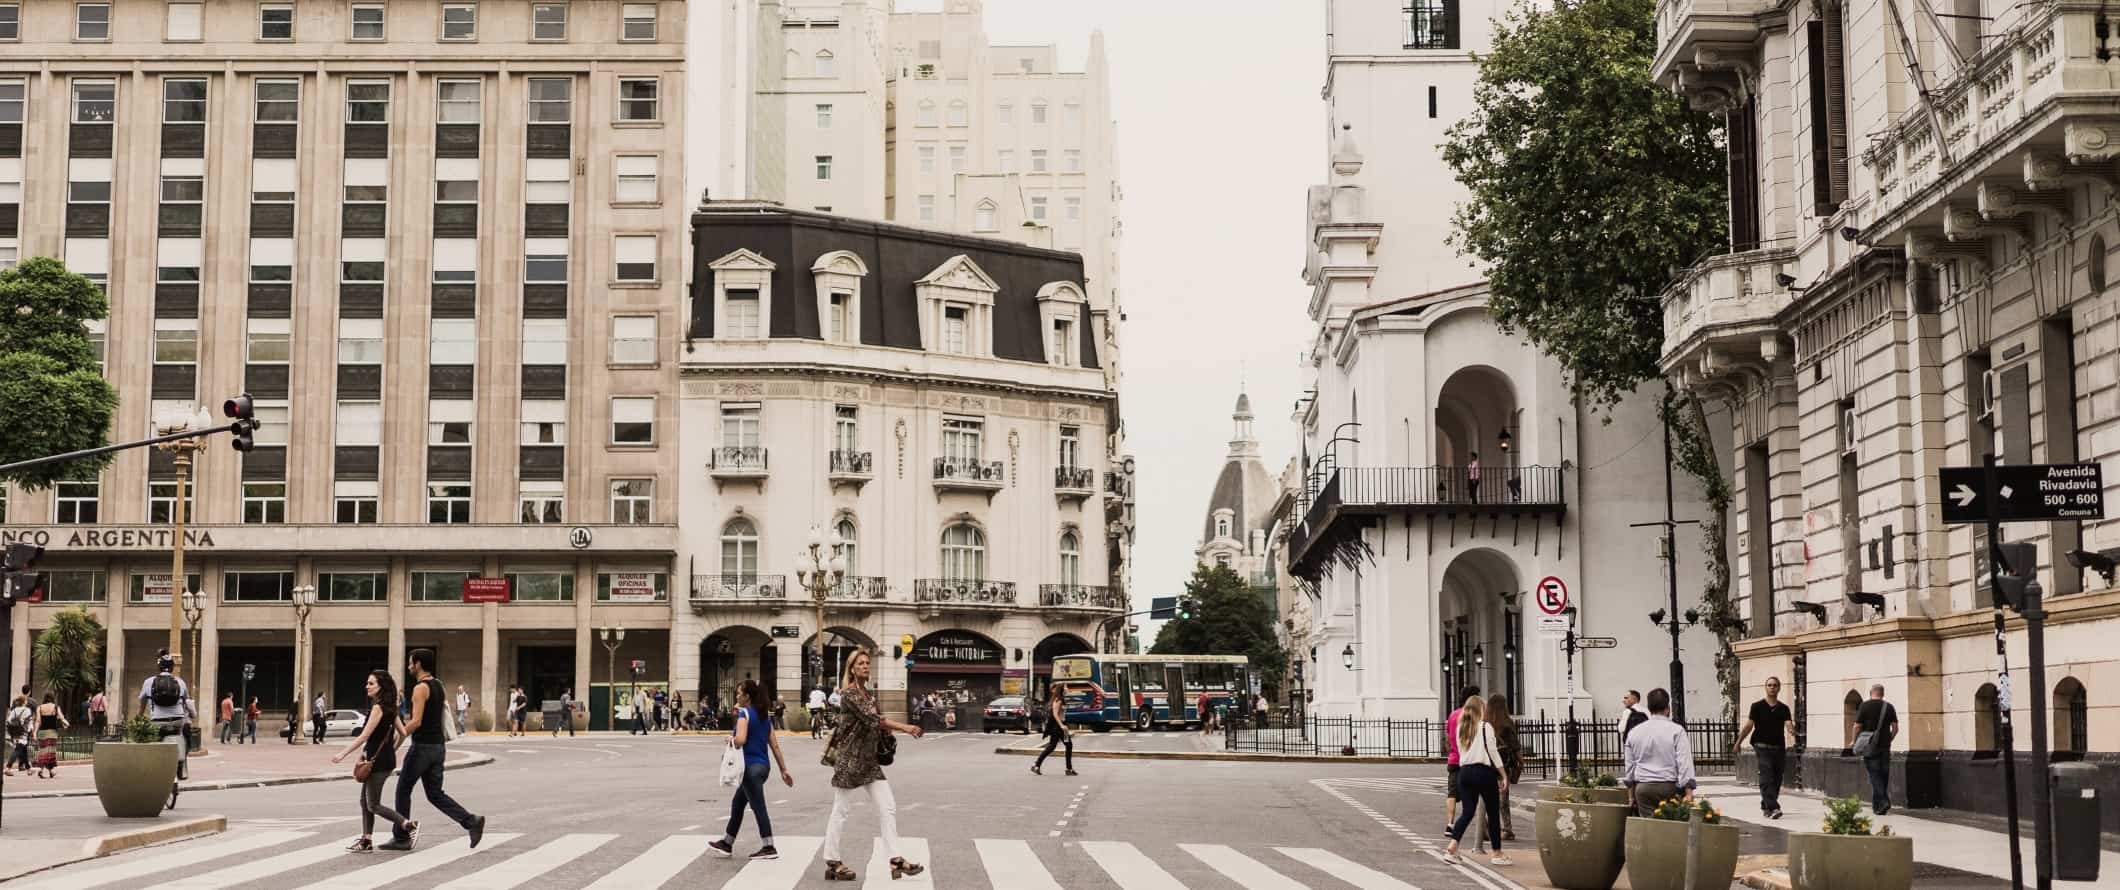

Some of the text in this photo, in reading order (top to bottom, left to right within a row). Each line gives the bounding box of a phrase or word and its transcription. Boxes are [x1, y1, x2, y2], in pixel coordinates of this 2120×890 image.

[2047, 466, 2096, 477] Avenida
[2039, 478, 2097, 490] Rivadavia
[1123, 459, 1135, 544] CITY
[2044, 494, 2066, 505] 500
[2076, 494, 2098, 504] 600
[2058, 507, 2098, 516] Comuna 1
[67, 530, 215, 546] ARGENTINA
[929, 646, 985, 660] GRAN VICTORIA
